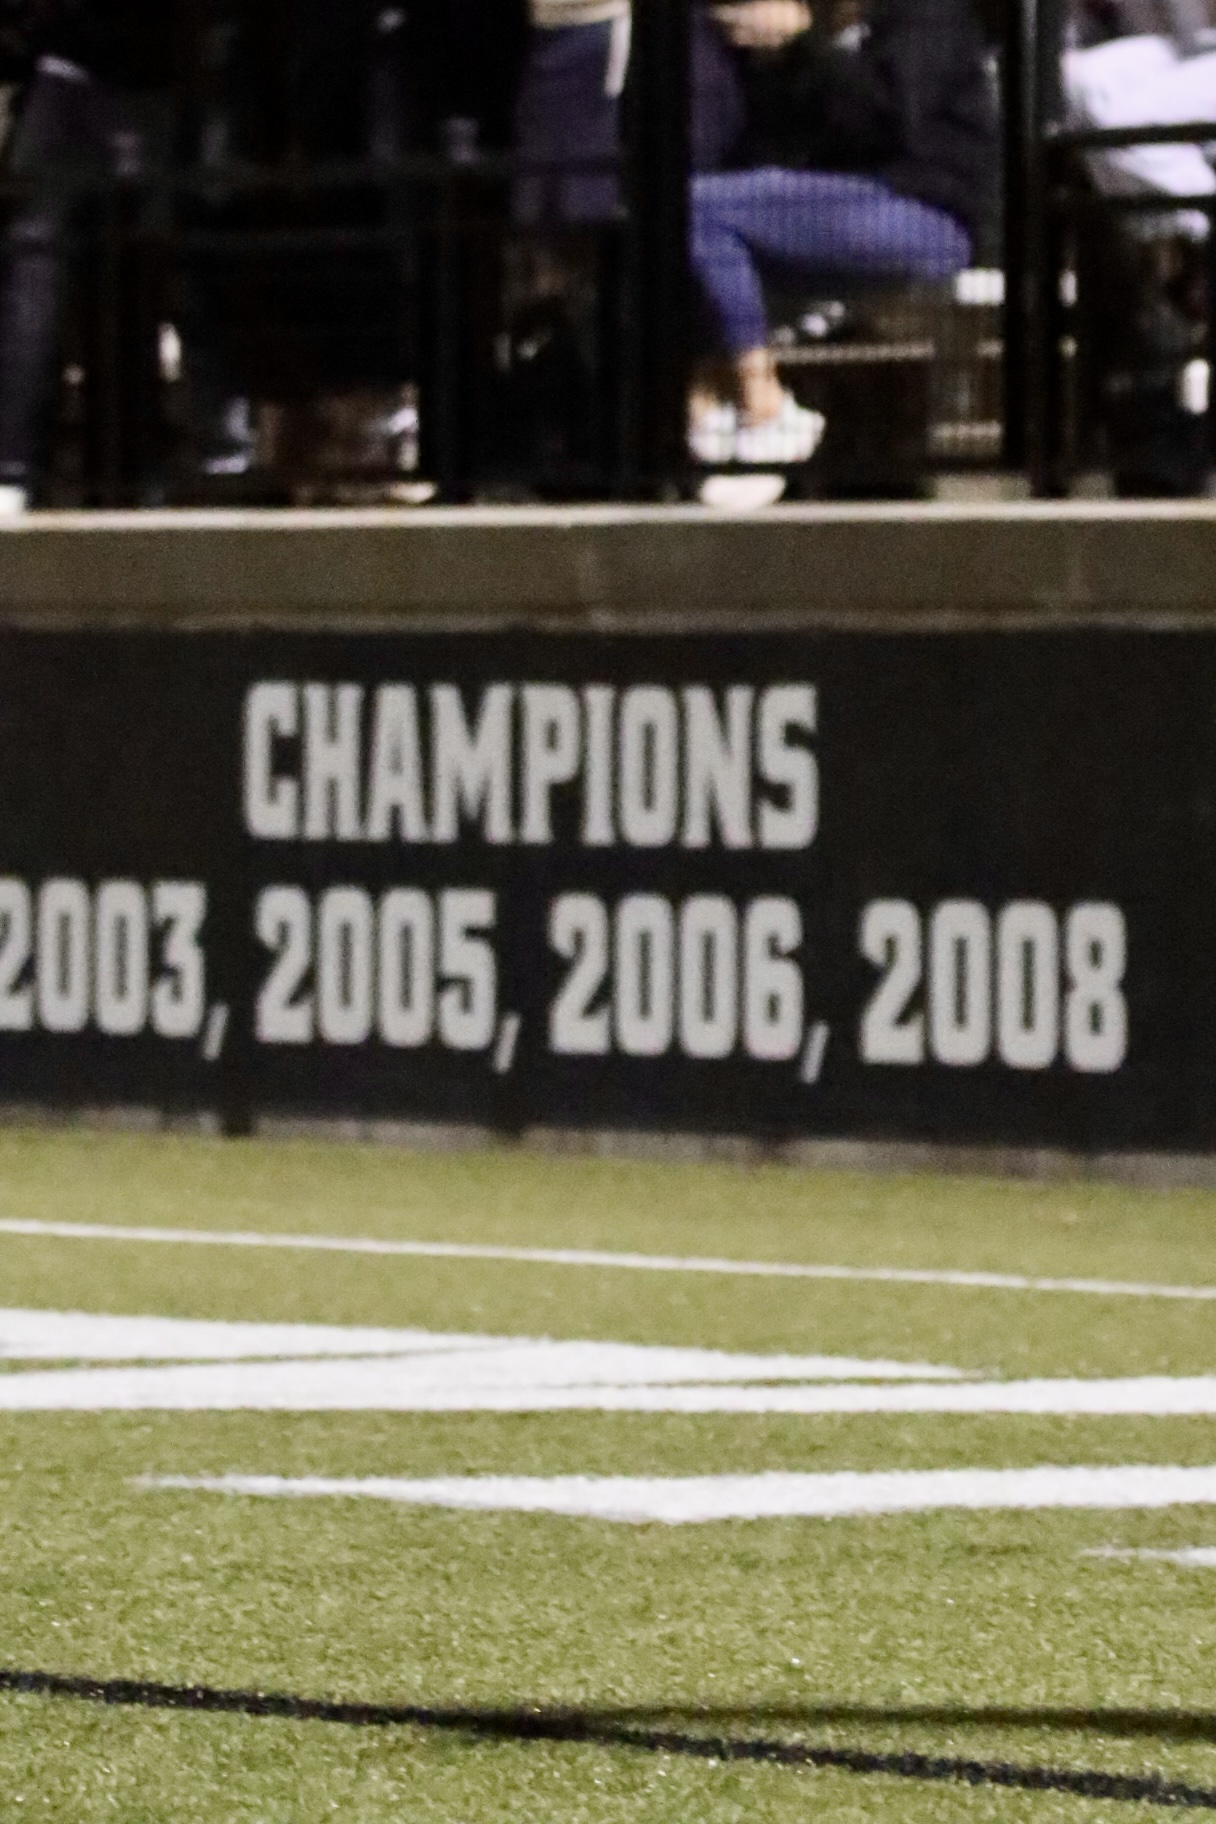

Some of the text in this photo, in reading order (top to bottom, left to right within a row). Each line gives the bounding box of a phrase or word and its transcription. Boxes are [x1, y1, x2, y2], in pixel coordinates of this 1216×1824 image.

[244, 680, 821, 849] CHAMPIONS
[255, 884, 520, 1075] 2005,
[548, 893, 829, 1084] 2006,
[858, 898, 1128, 1074] 2008
